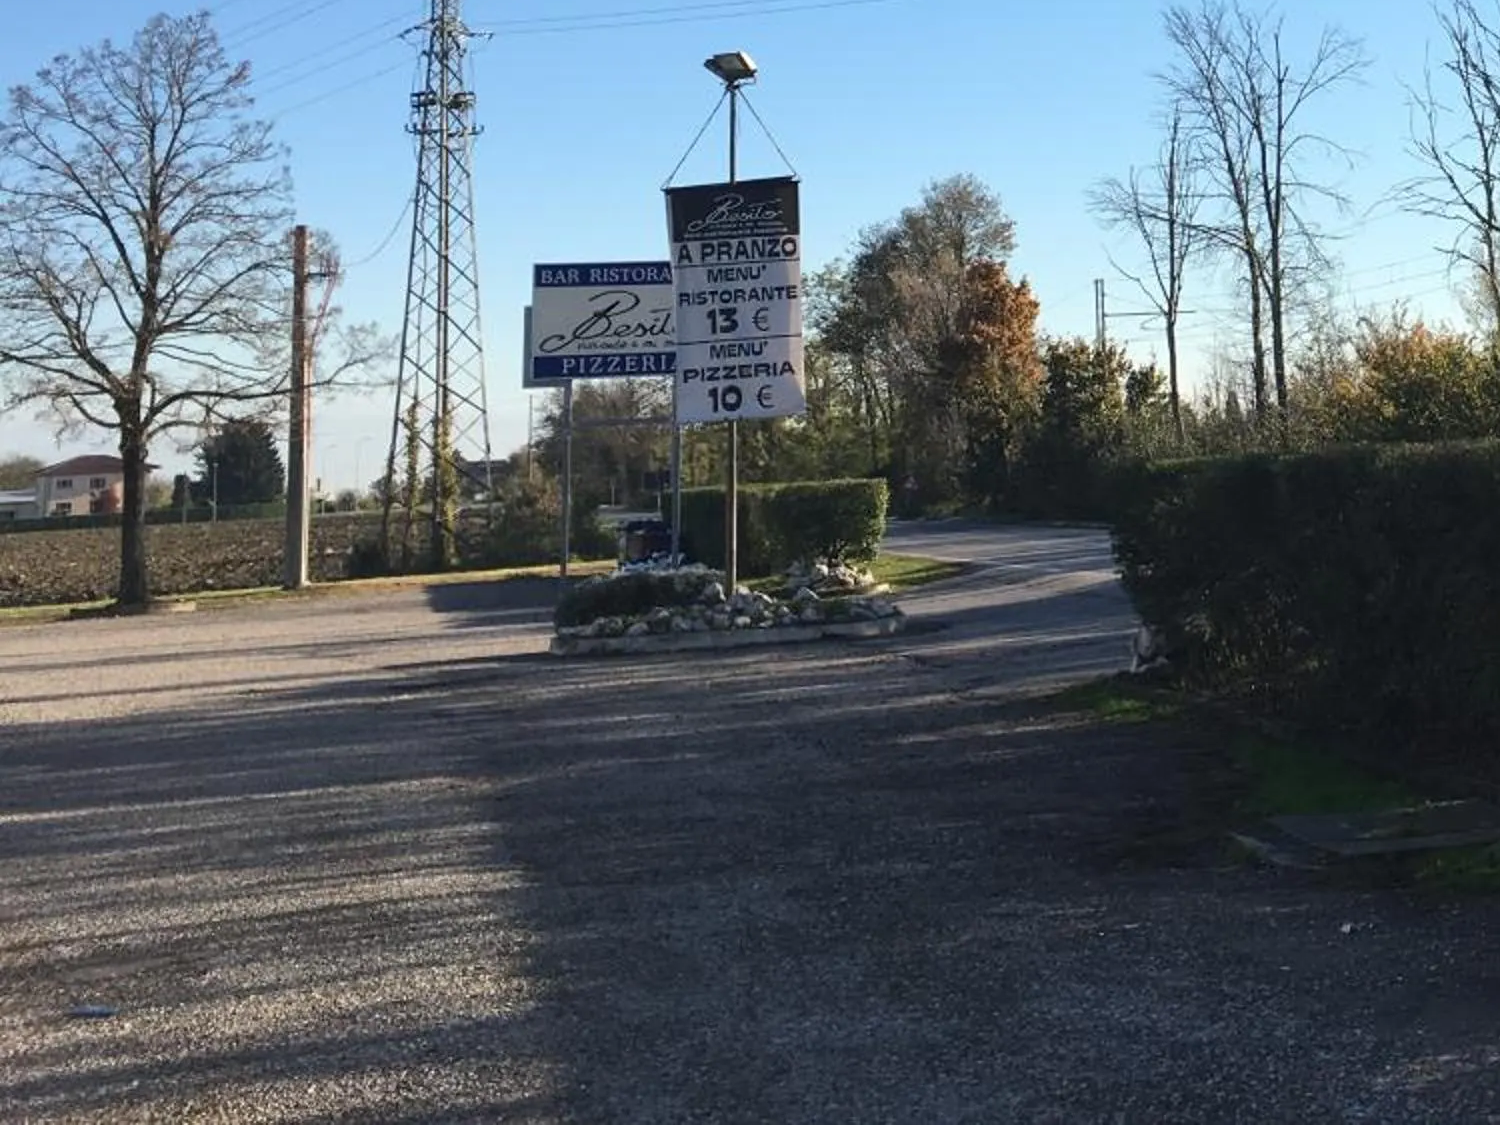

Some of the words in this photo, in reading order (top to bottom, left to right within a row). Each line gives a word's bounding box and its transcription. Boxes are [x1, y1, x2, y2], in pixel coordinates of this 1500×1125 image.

[677, 243, 693, 264] A
[700, 236, 797, 262] PRANZO
[541, 268, 579, 285] BAR
[678, 284, 798, 308] RISTORANTE
[538, 290, 675, 353] Besit
[706, 307, 738, 335] 13
[751, 306, 770, 331] €
[682, 361, 796, 384] PIZZERIA
[708, 385, 743, 413] 10
[756, 384, 775, 408] €
